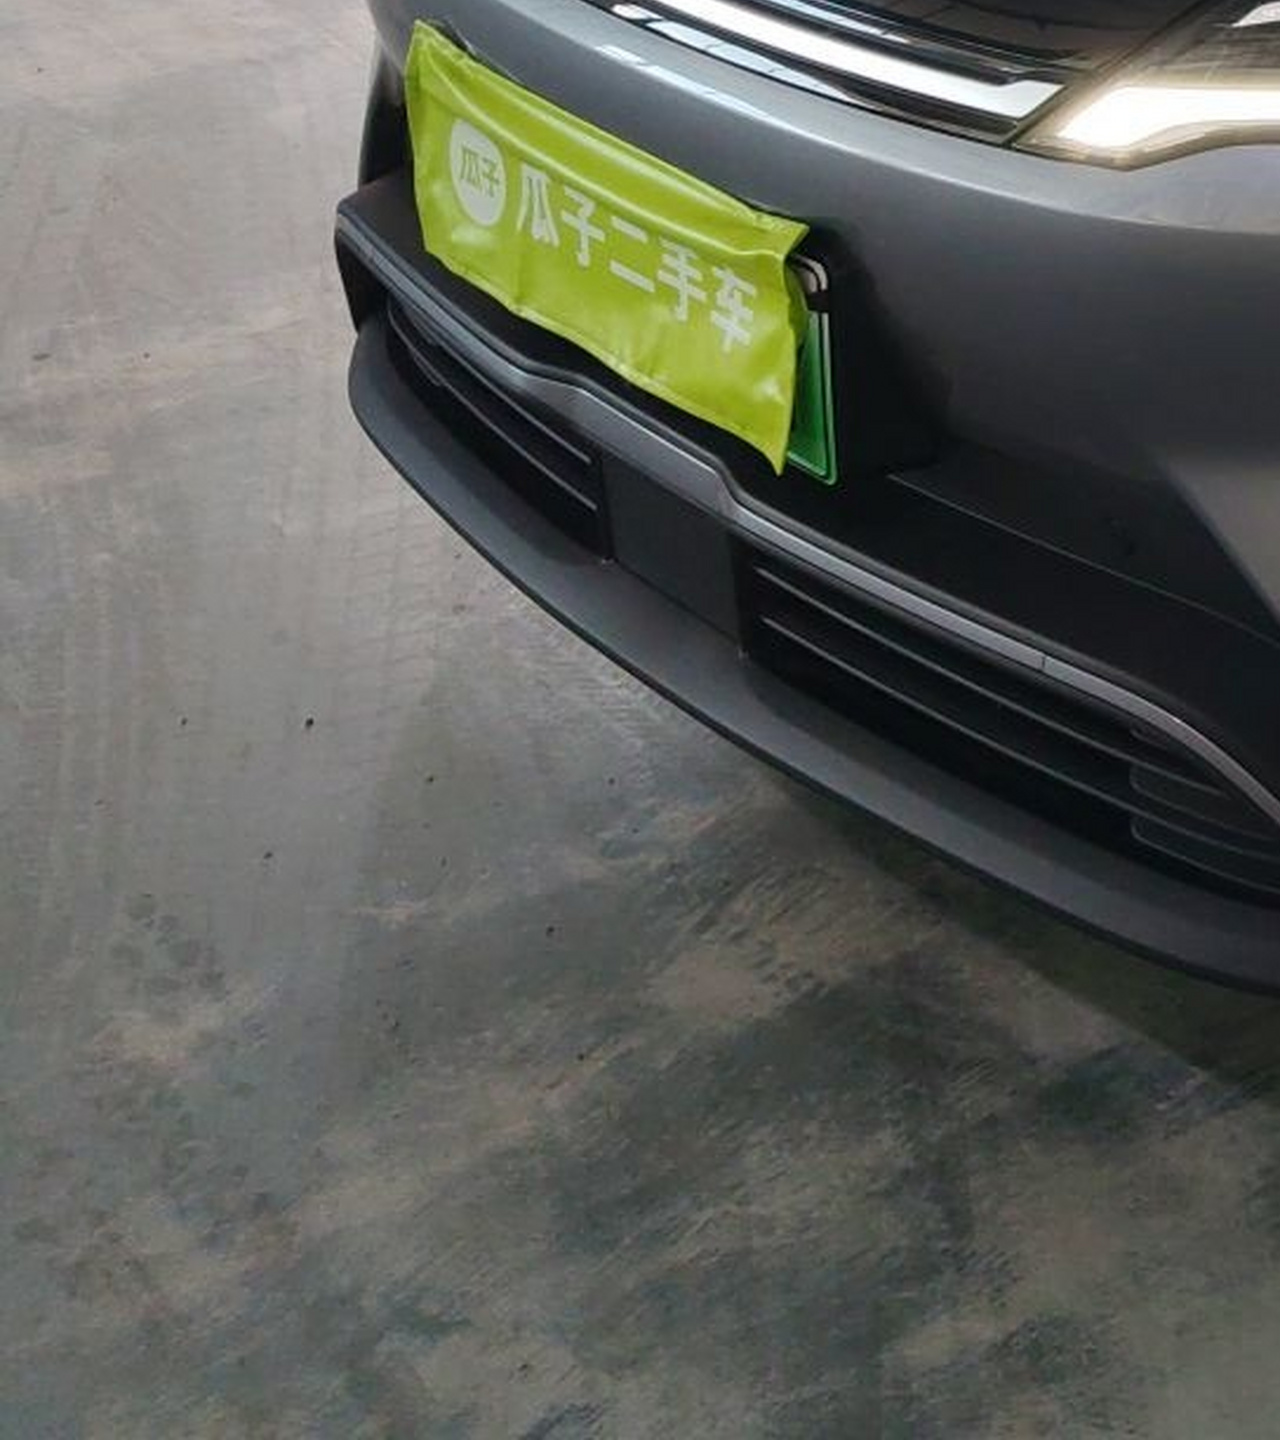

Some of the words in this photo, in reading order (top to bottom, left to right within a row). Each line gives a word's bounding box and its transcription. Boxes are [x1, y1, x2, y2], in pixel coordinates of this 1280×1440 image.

[460, 144, 501, 199] 瓜子
[515, 160, 757, 354] 瓜子二手车
